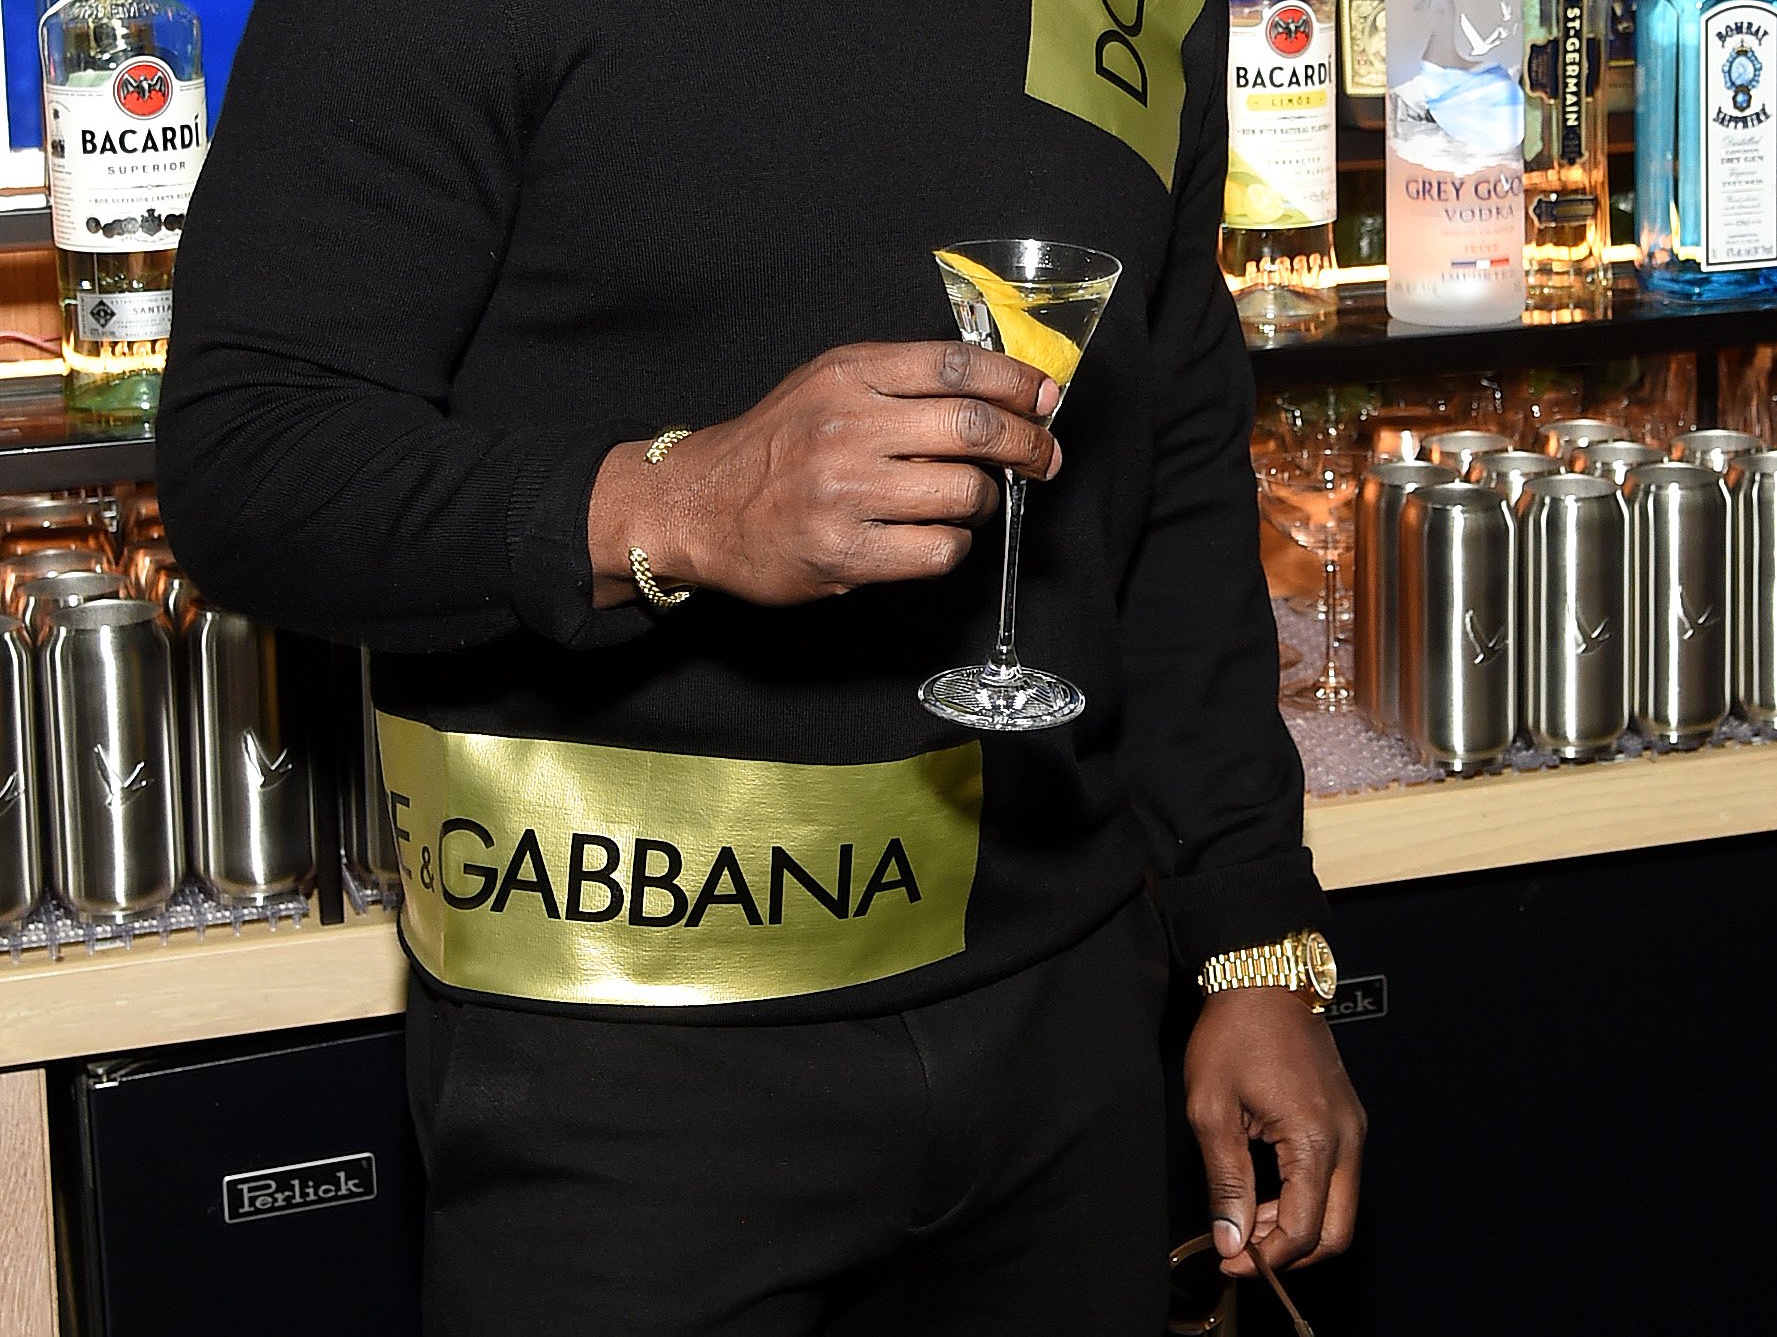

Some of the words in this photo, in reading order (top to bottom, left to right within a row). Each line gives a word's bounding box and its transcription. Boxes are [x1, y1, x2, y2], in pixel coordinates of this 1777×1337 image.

[1235, 54, 1332, 89] BACARDÍ
[1565, 6, 1581, 127] ST-GERMAIN
[81, 113, 201, 155] BACARDÍ
[107, 161, 187, 175] SUPERIOR
[1404, 176, 1465, 202] GREY
[1444, 205, 1515, 223] VODKA
[420, 845, 436, 894] &
[438, 816, 923, 928] GABBANA
[236, 1170, 365, 1214] Perlick
